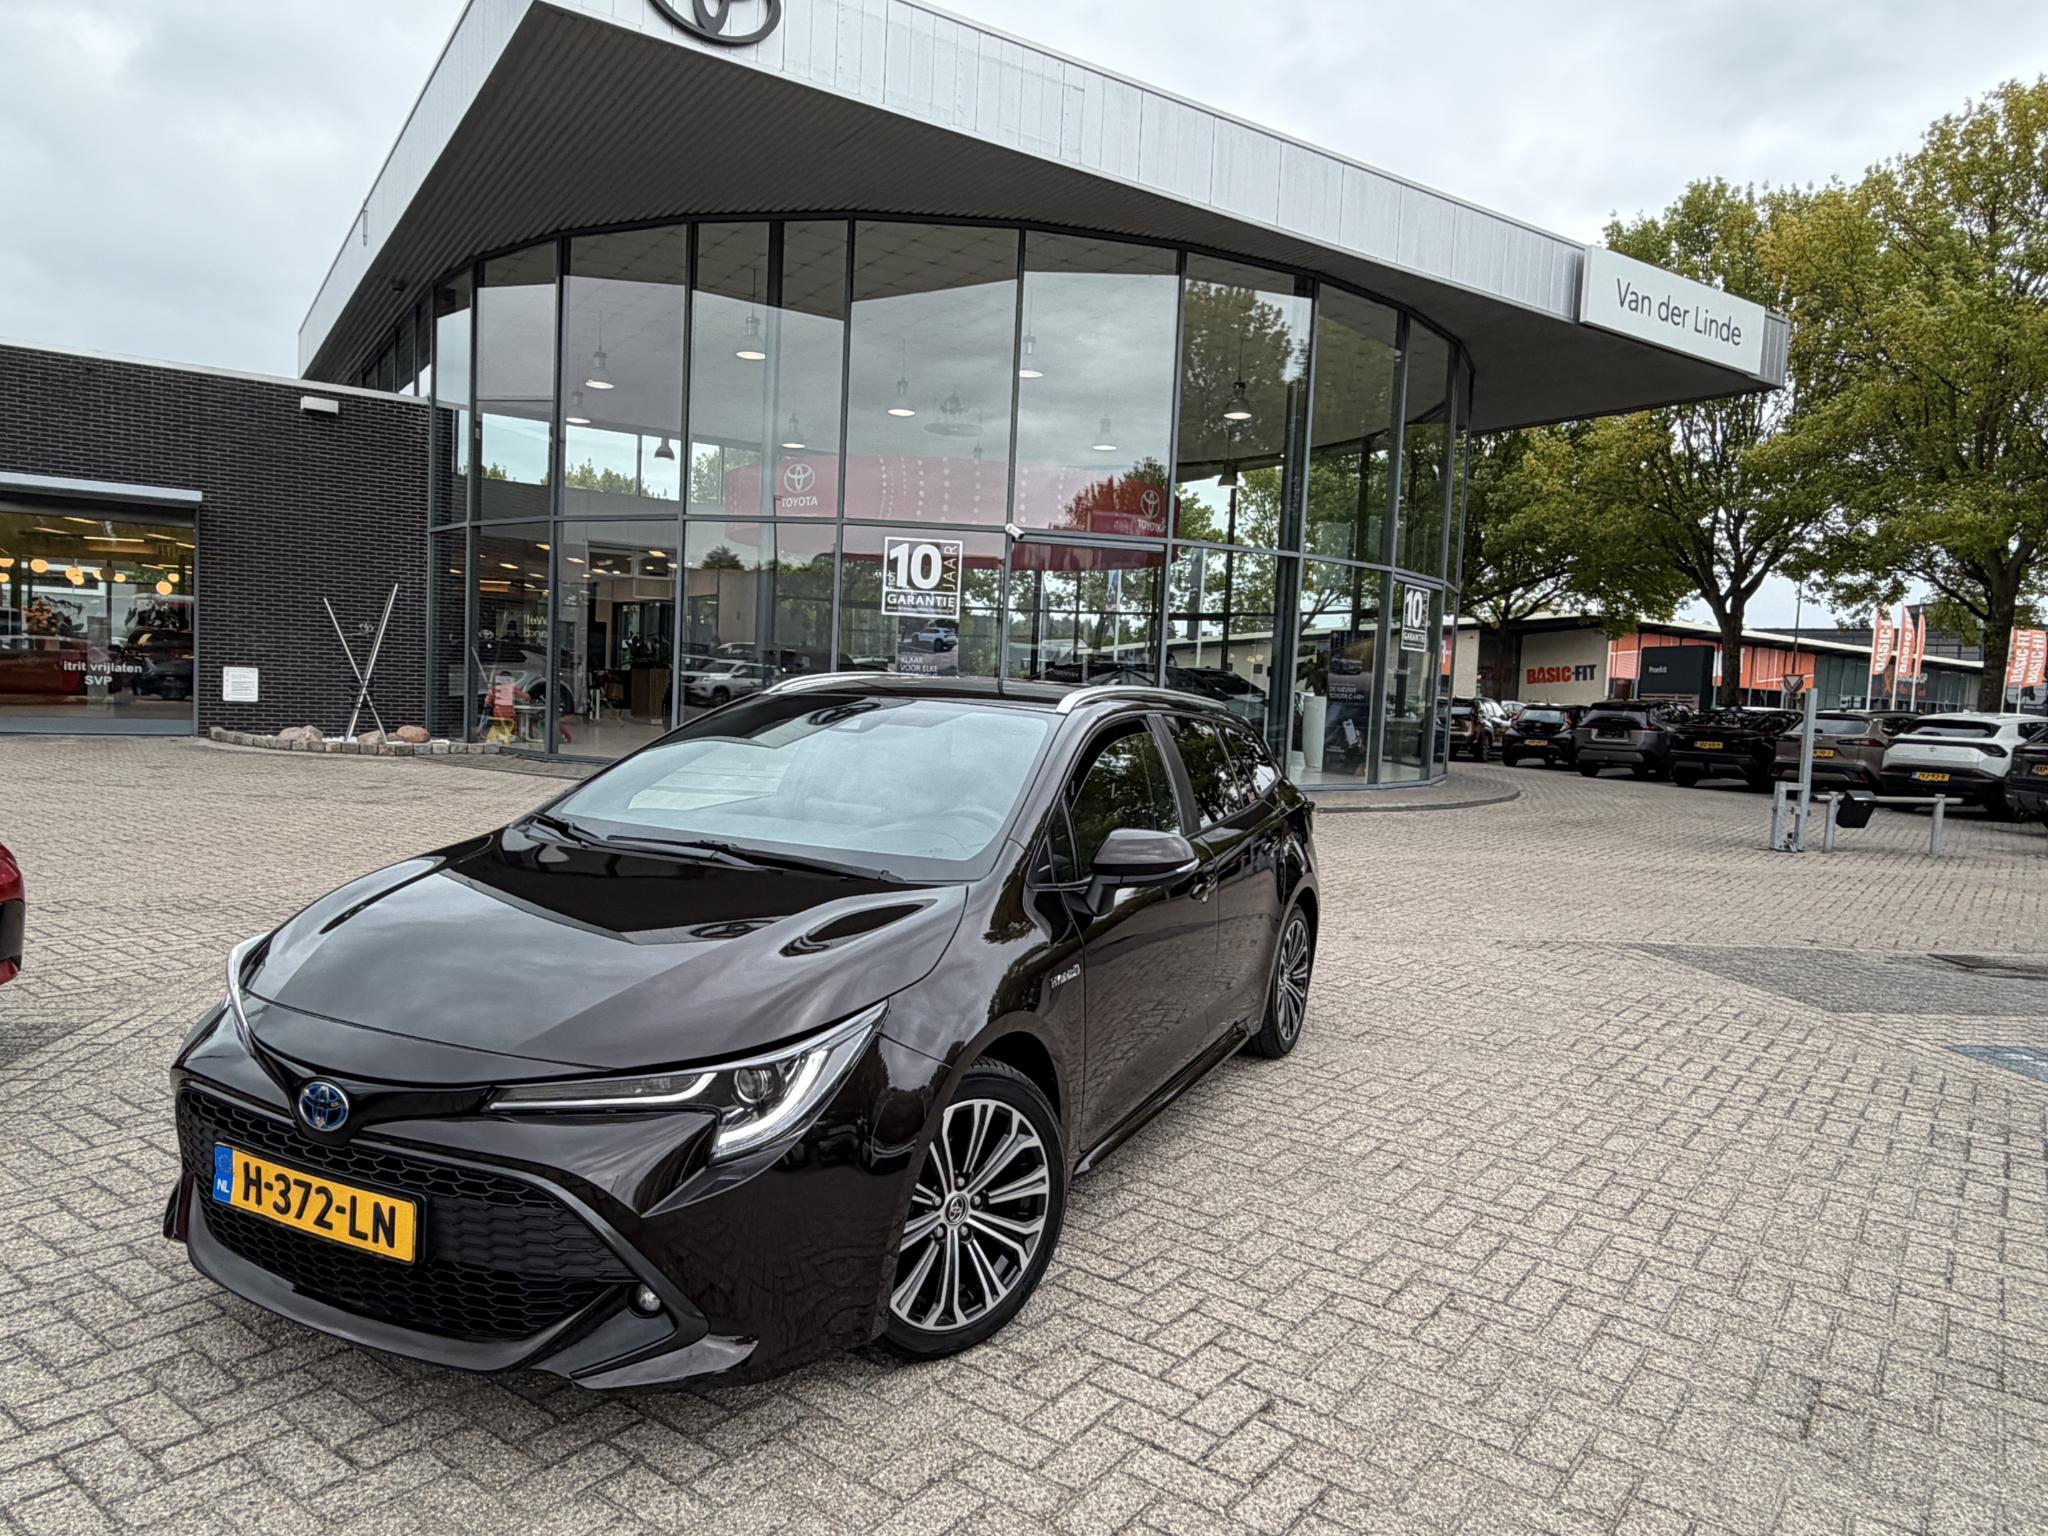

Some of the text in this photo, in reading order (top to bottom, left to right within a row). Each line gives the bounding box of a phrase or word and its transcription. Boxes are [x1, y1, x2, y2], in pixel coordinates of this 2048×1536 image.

[1616, 278, 1743, 347] Van der Linde
[781, 496, 818, 508] TOYOTA
[889, 542, 943, 590] 10
[942, 544, 959, 591] JAAR
[886, 593, 957, 609] GARANTIE
[1406, 589, 1423, 628] 10
[84, 674, 113, 686] SVP
[89, 661, 143, 675] vrijlaten
[216, 1176, 230, 1194] NL
[242, 1160, 397, 1250] H-372-LN
